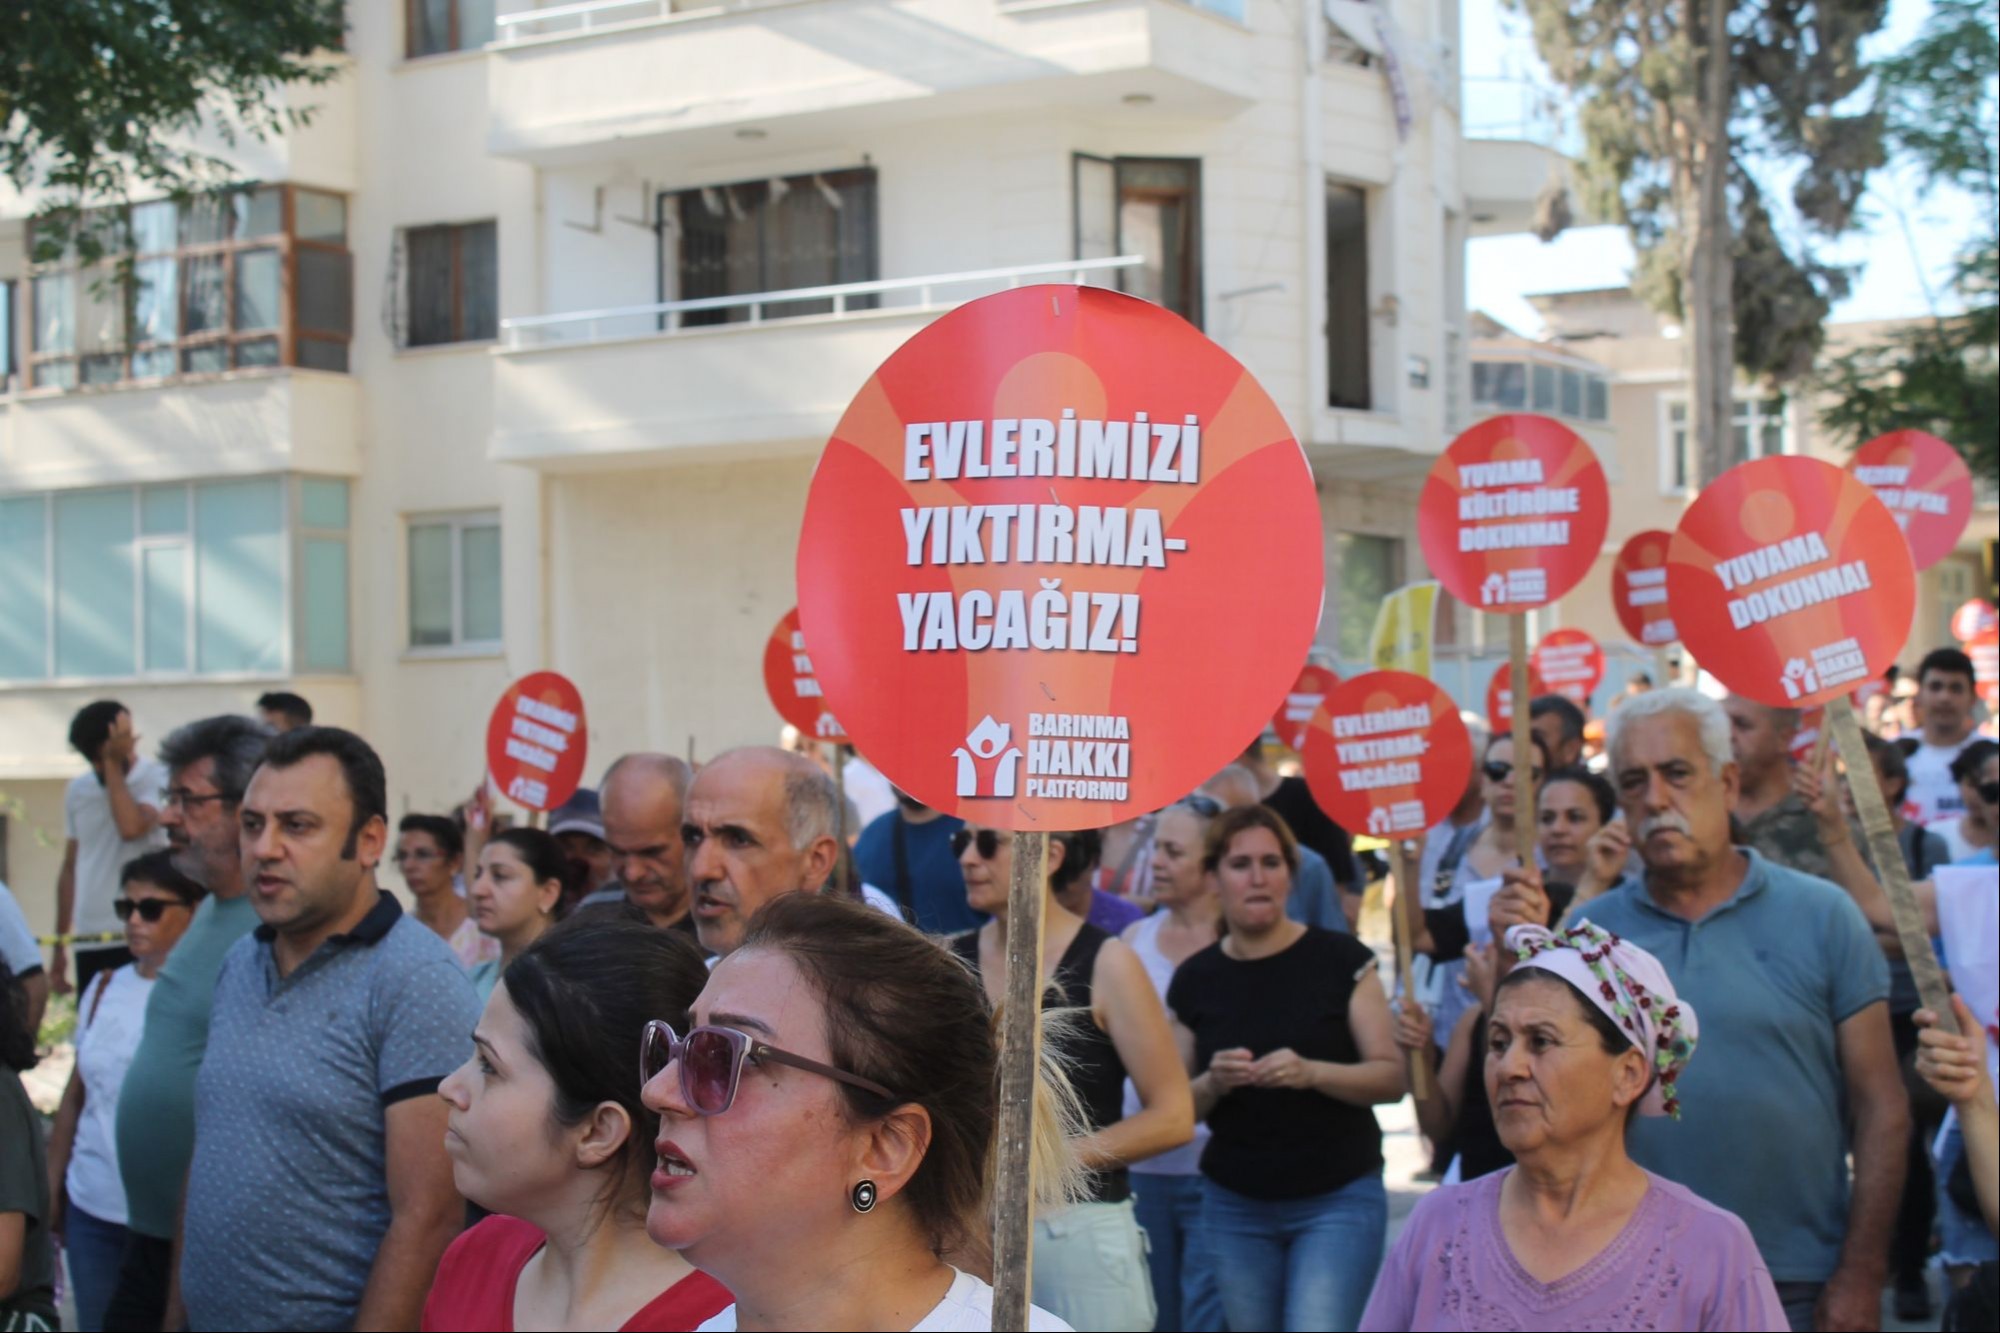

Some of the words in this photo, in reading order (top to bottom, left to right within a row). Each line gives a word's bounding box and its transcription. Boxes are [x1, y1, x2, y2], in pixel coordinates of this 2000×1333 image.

[904, 408, 1200, 484] EVLERİMİZİ
[1458, 457, 1543, 489] YUVAMA
[900, 504, 1187, 568] YIKTIRMA-
[1458, 520, 1569, 552] DOKUNMA!
[1713, 530, 1829, 591] YUVAMA
[897, 577, 1140, 653] YACAĞIZ!
[1727, 559, 1872, 630] DOKUNMA!
[1028, 713, 1130, 740] BARINMA
[1027, 739, 1130, 778] HAKKI
[1026, 778, 1128, 801] PLATFORMU
